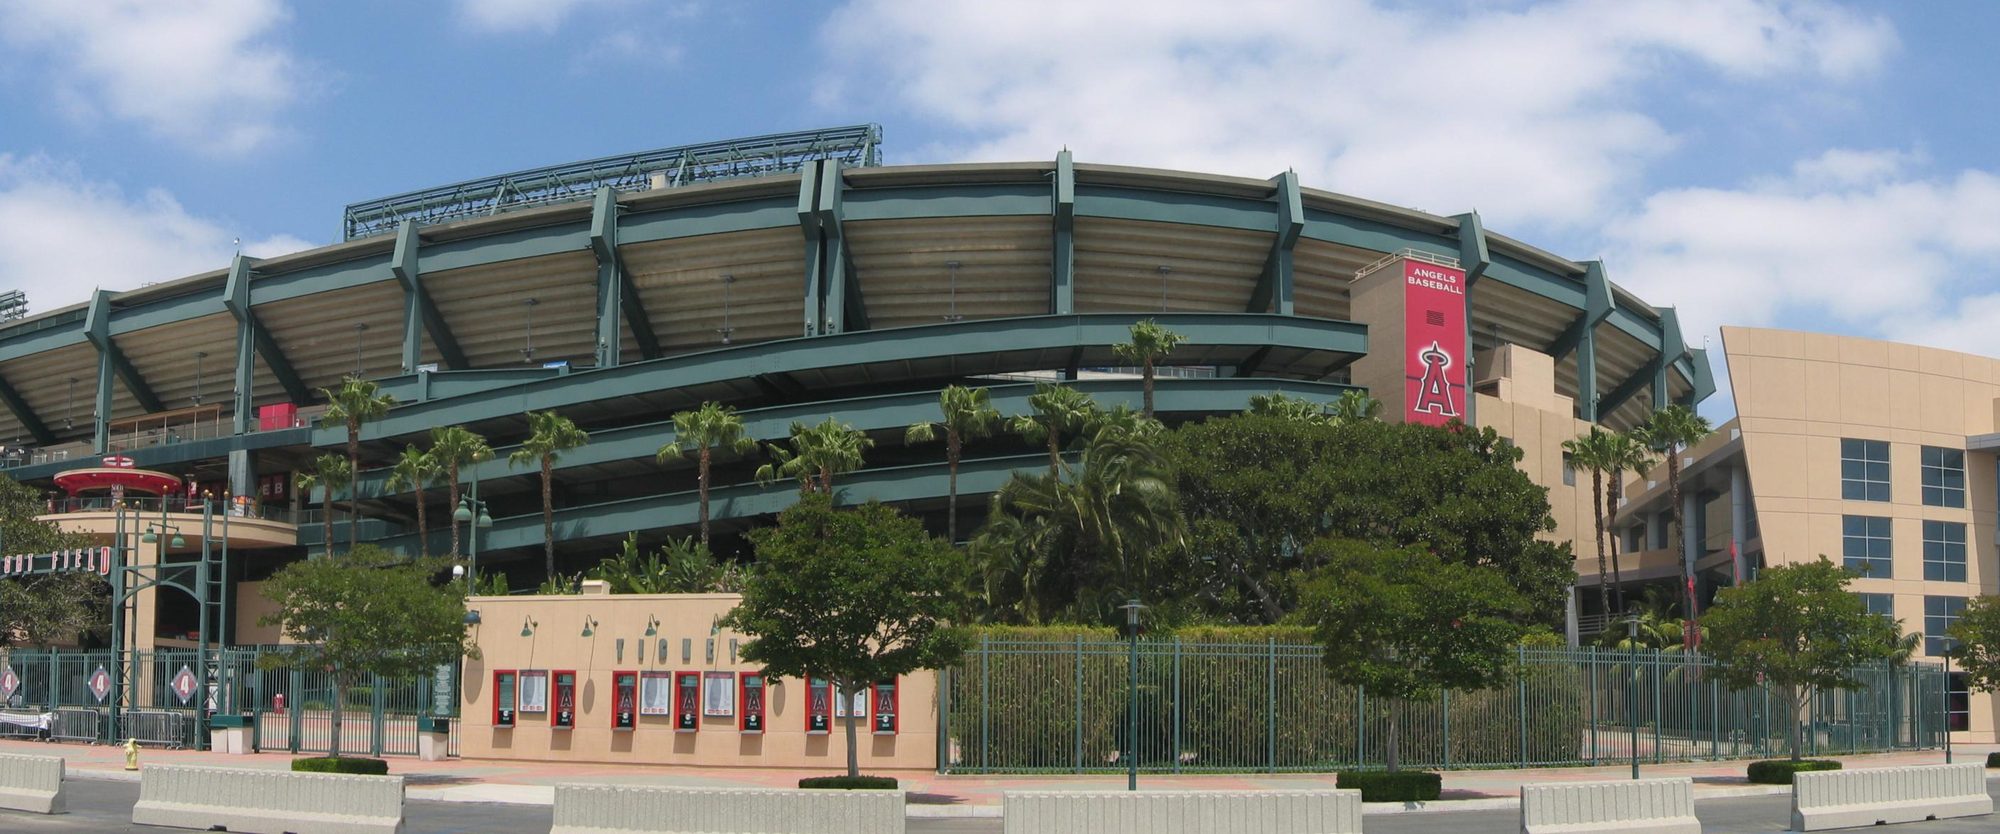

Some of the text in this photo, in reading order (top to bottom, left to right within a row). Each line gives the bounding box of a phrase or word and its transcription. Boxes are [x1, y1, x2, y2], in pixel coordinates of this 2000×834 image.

[1414, 268, 1456, 283] ANGELS
[1408, 276, 1462, 294] BASEBALL
[1414, 340, 1456, 417] A
[52, 546, 110, 575] FIELD
[4, 674, 12, 690] 4
[96, 675, 104, 692] 4
[181, 675, 189, 693] 4
